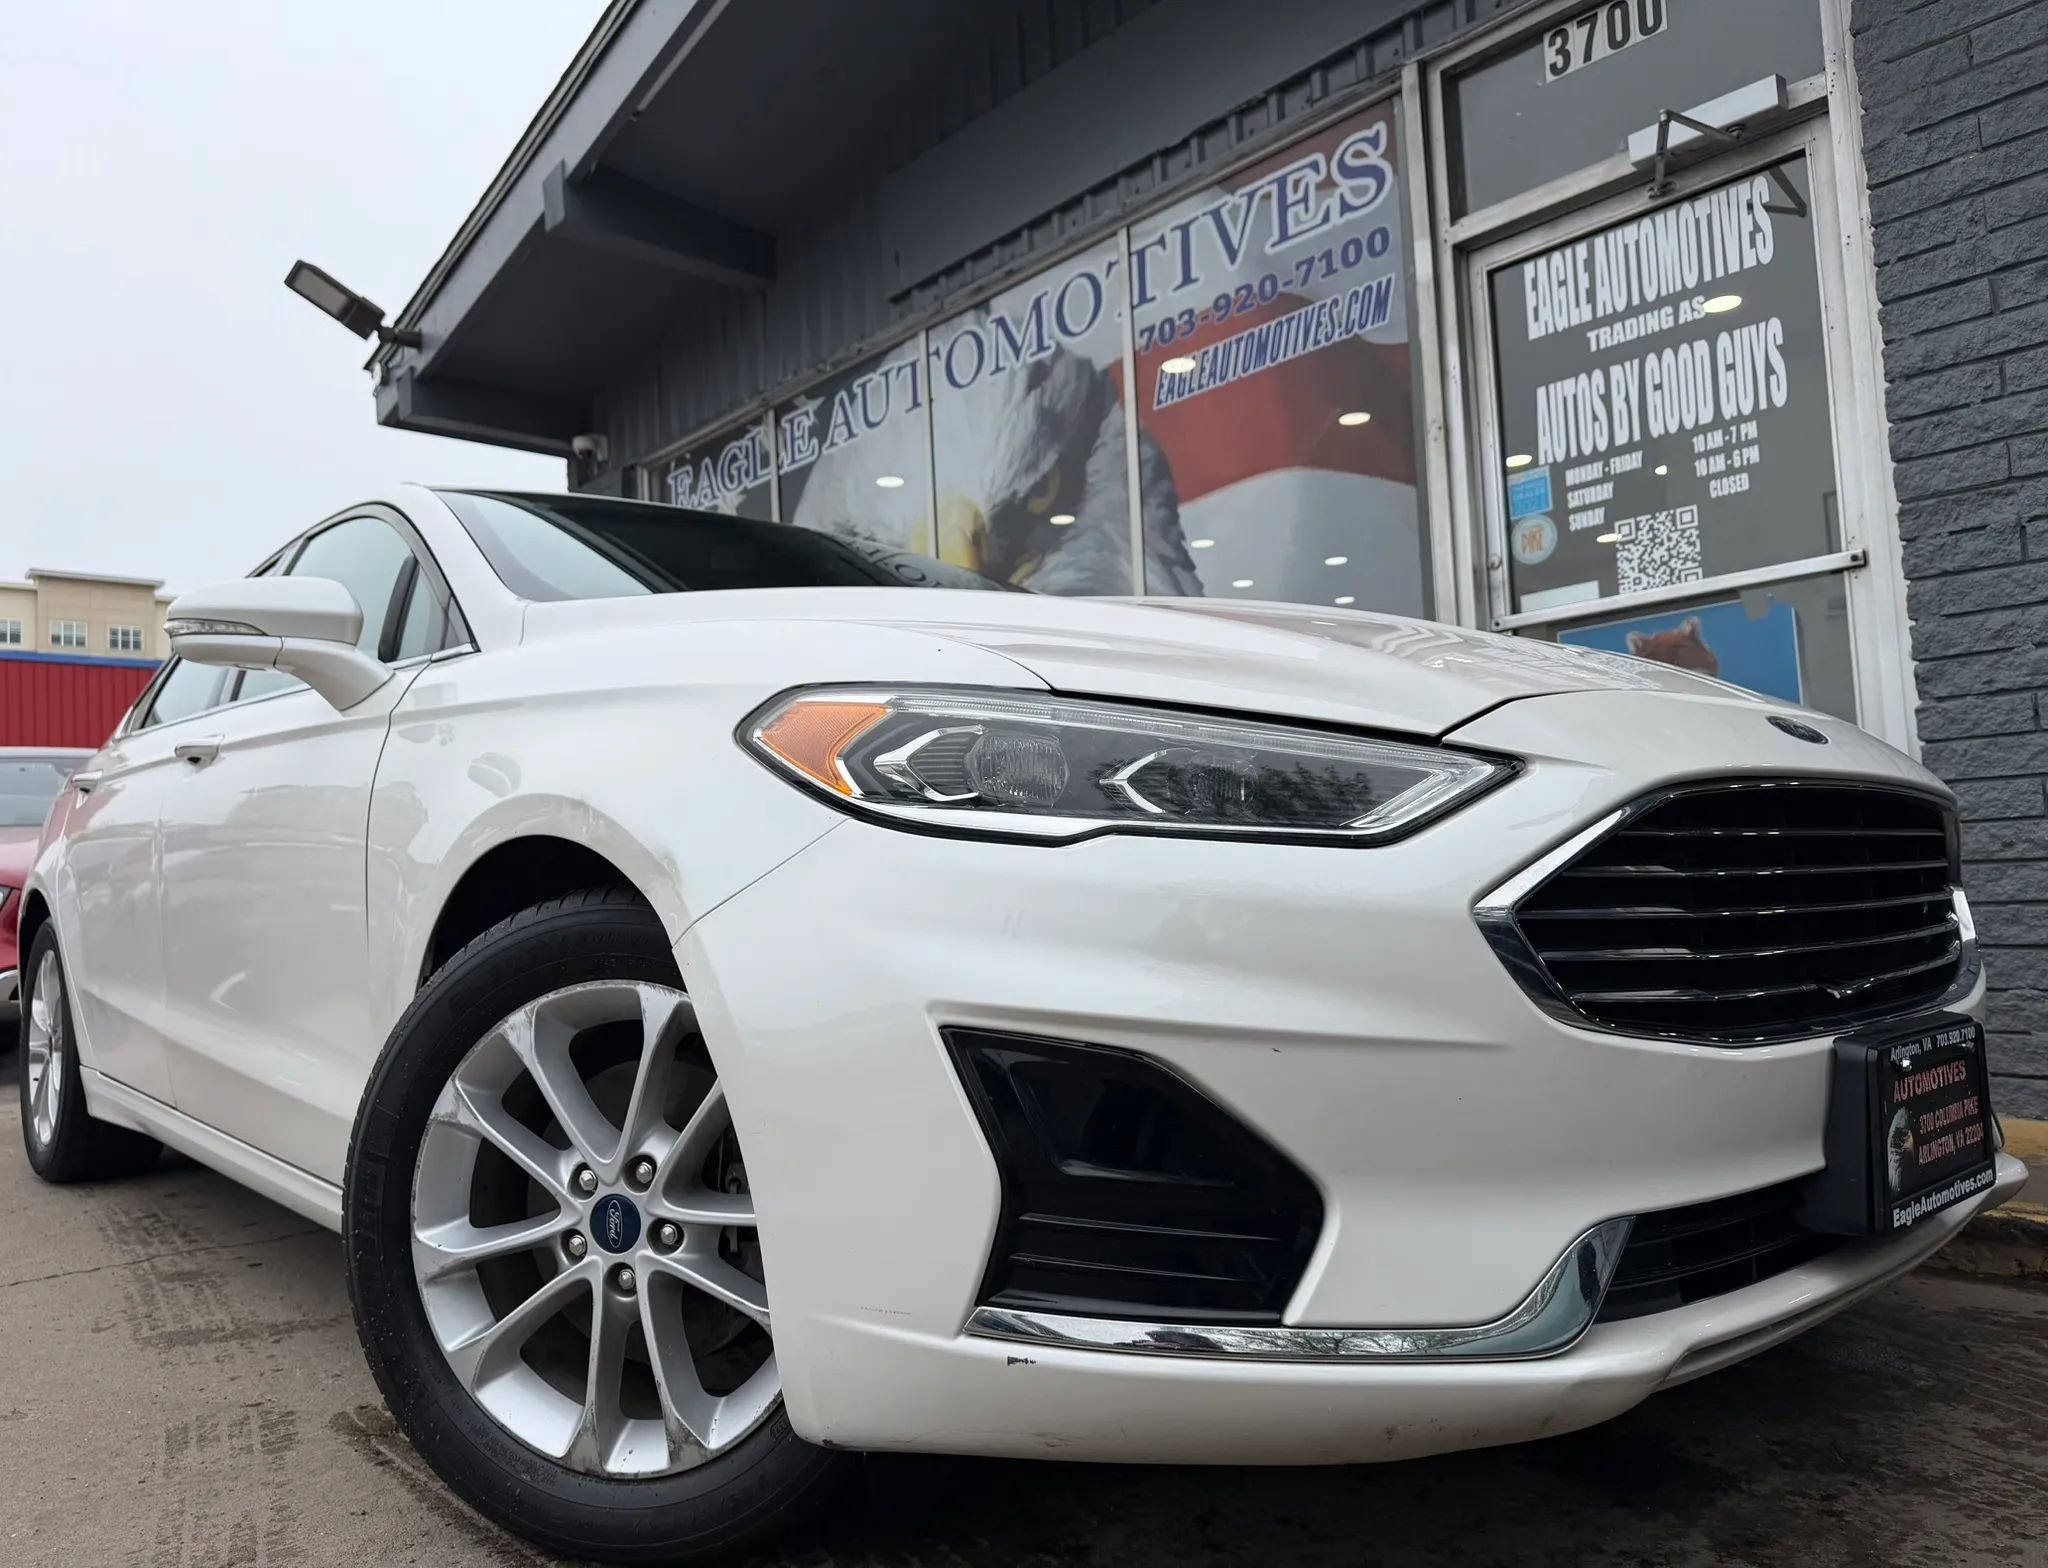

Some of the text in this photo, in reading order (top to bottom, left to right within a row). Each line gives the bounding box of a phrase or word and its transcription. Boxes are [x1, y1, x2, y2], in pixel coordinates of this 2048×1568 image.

[1548, 0, 1662, 76] 3700
[1523, 176, 1774, 340] EAGLE AUTOMOTIVES
[1139, 226, 1391, 354] 703-920-7100
[668, 121, 1392, 510] EAGLE AUTOMOTIVES
[1586, 295, 1706, 352] TRADING AS
[1536, 317, 1788, 465] AUTOS BY GOOD GUYS
[1692, 433, 1705, 453] 10
[1706, 428, 1724, 451] AM
[1729, 425, 1737, 444] 7
[1740, 420, 1758, 441] PM
[1565, 460, 1604, 487] MONDAY
[1610, 450, 1643, 475] FRIDAY
[1694, 457, 1707, 478] 10
[1708, 453, 1726, 475] AM
[1732, 448, 1741, 468] 6
[1742, 444, 1760, 466] PM
[1567, 481, 1614, 509] SATURDAY
[1709, 472, 1750, 499] CLOSED
[1569, 507, 1605, 532] SUNDAY
[1890, 1042, 1922, 1062] Arlington,
[1922, 1037, 1933, 1052] VA
[1893, 1060, 1966, 1104] AUTOMOTIVES
[1919, 1111, 1935, 1135] 3700
[1935, 1101, 1964, 1129] COLUMBIA
[1893, 1168, 1994, 1229] EagleAutomotives.com
[609, 1208, 621, 1241] Ford
